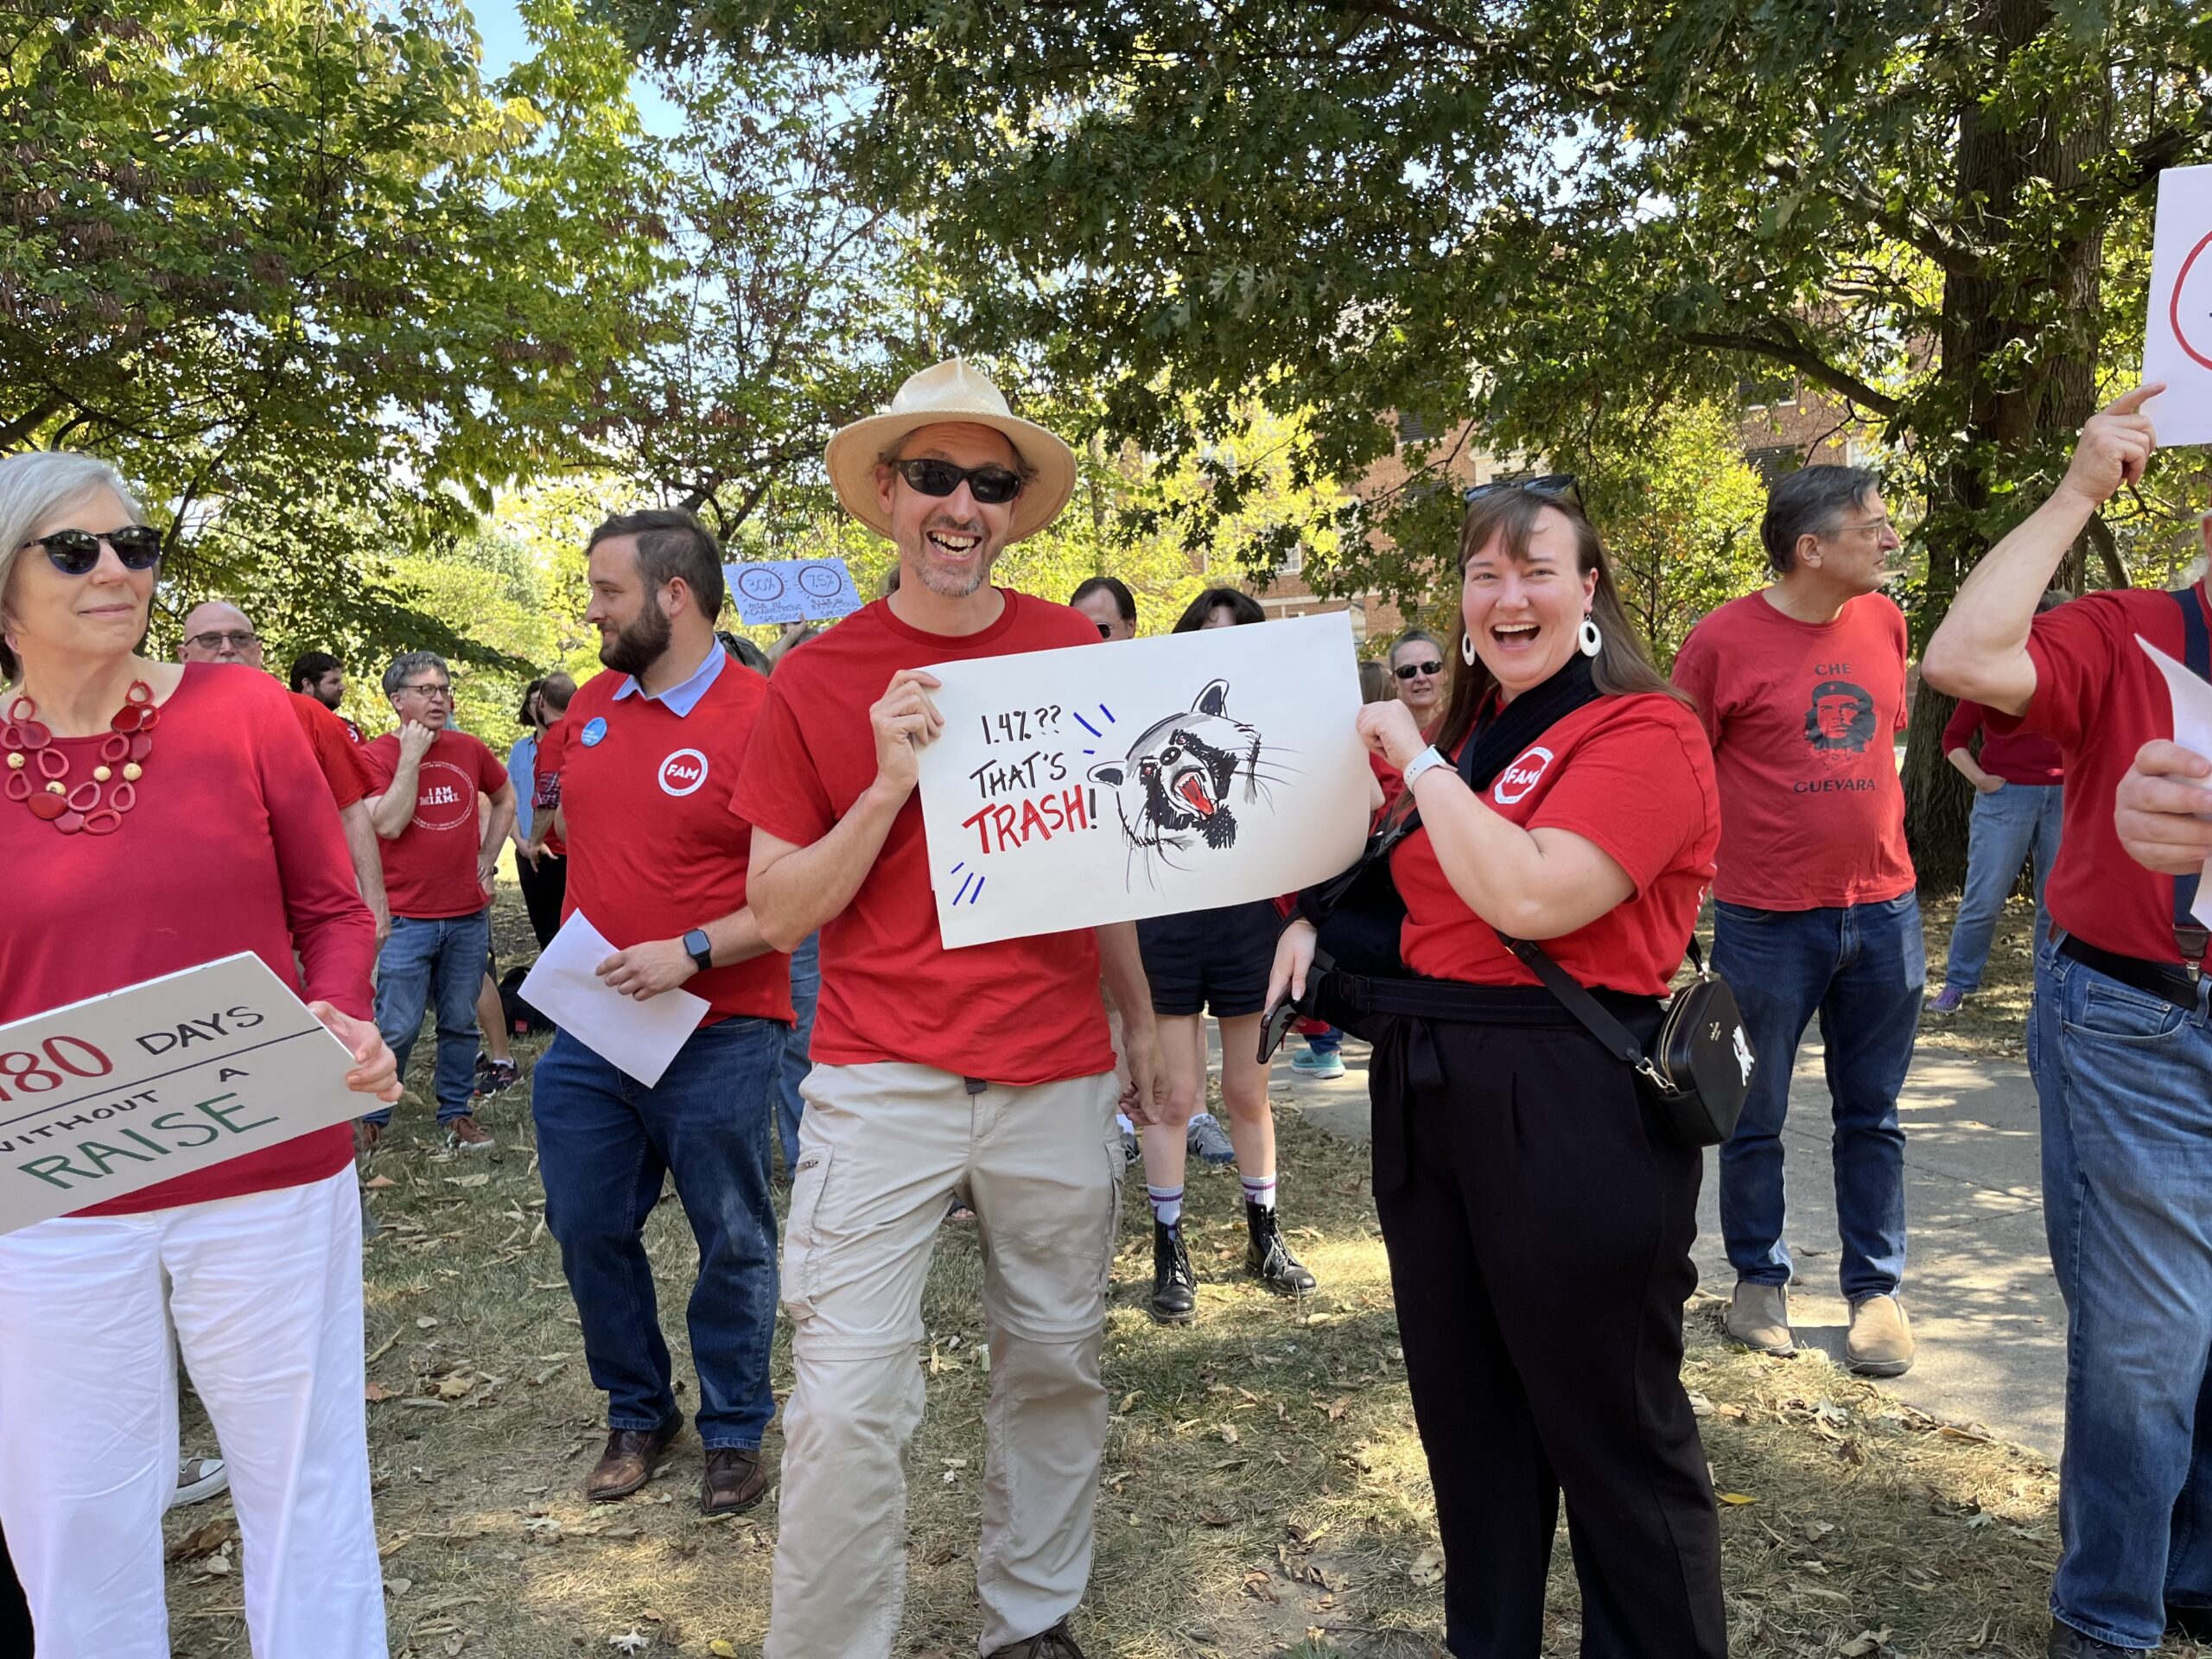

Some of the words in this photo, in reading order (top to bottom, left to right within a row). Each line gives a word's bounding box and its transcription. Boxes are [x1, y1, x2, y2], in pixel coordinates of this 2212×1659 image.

[806, 574, 836, 589] 7.5%
[1815, 663, 1852, 676] CHE
[981, 704, 1062, 745] 1.4%??
[666, 763, 701, 781] FAM
[969, 750, 1067, 798] THAT'S
[1504, 768, 1541, 785] FAM
[428, 787, 433, 796] I
[435, 785, 453, 796] AM
[1793, 779, 1876, 793] GUEVARA
[961, 784, 1097, 855] TRASH!
[135, 1006, 264, 1057] DAYS
[219, 1068, 251, 1083] A
[16, 1092, 280, 1190] RAISE
